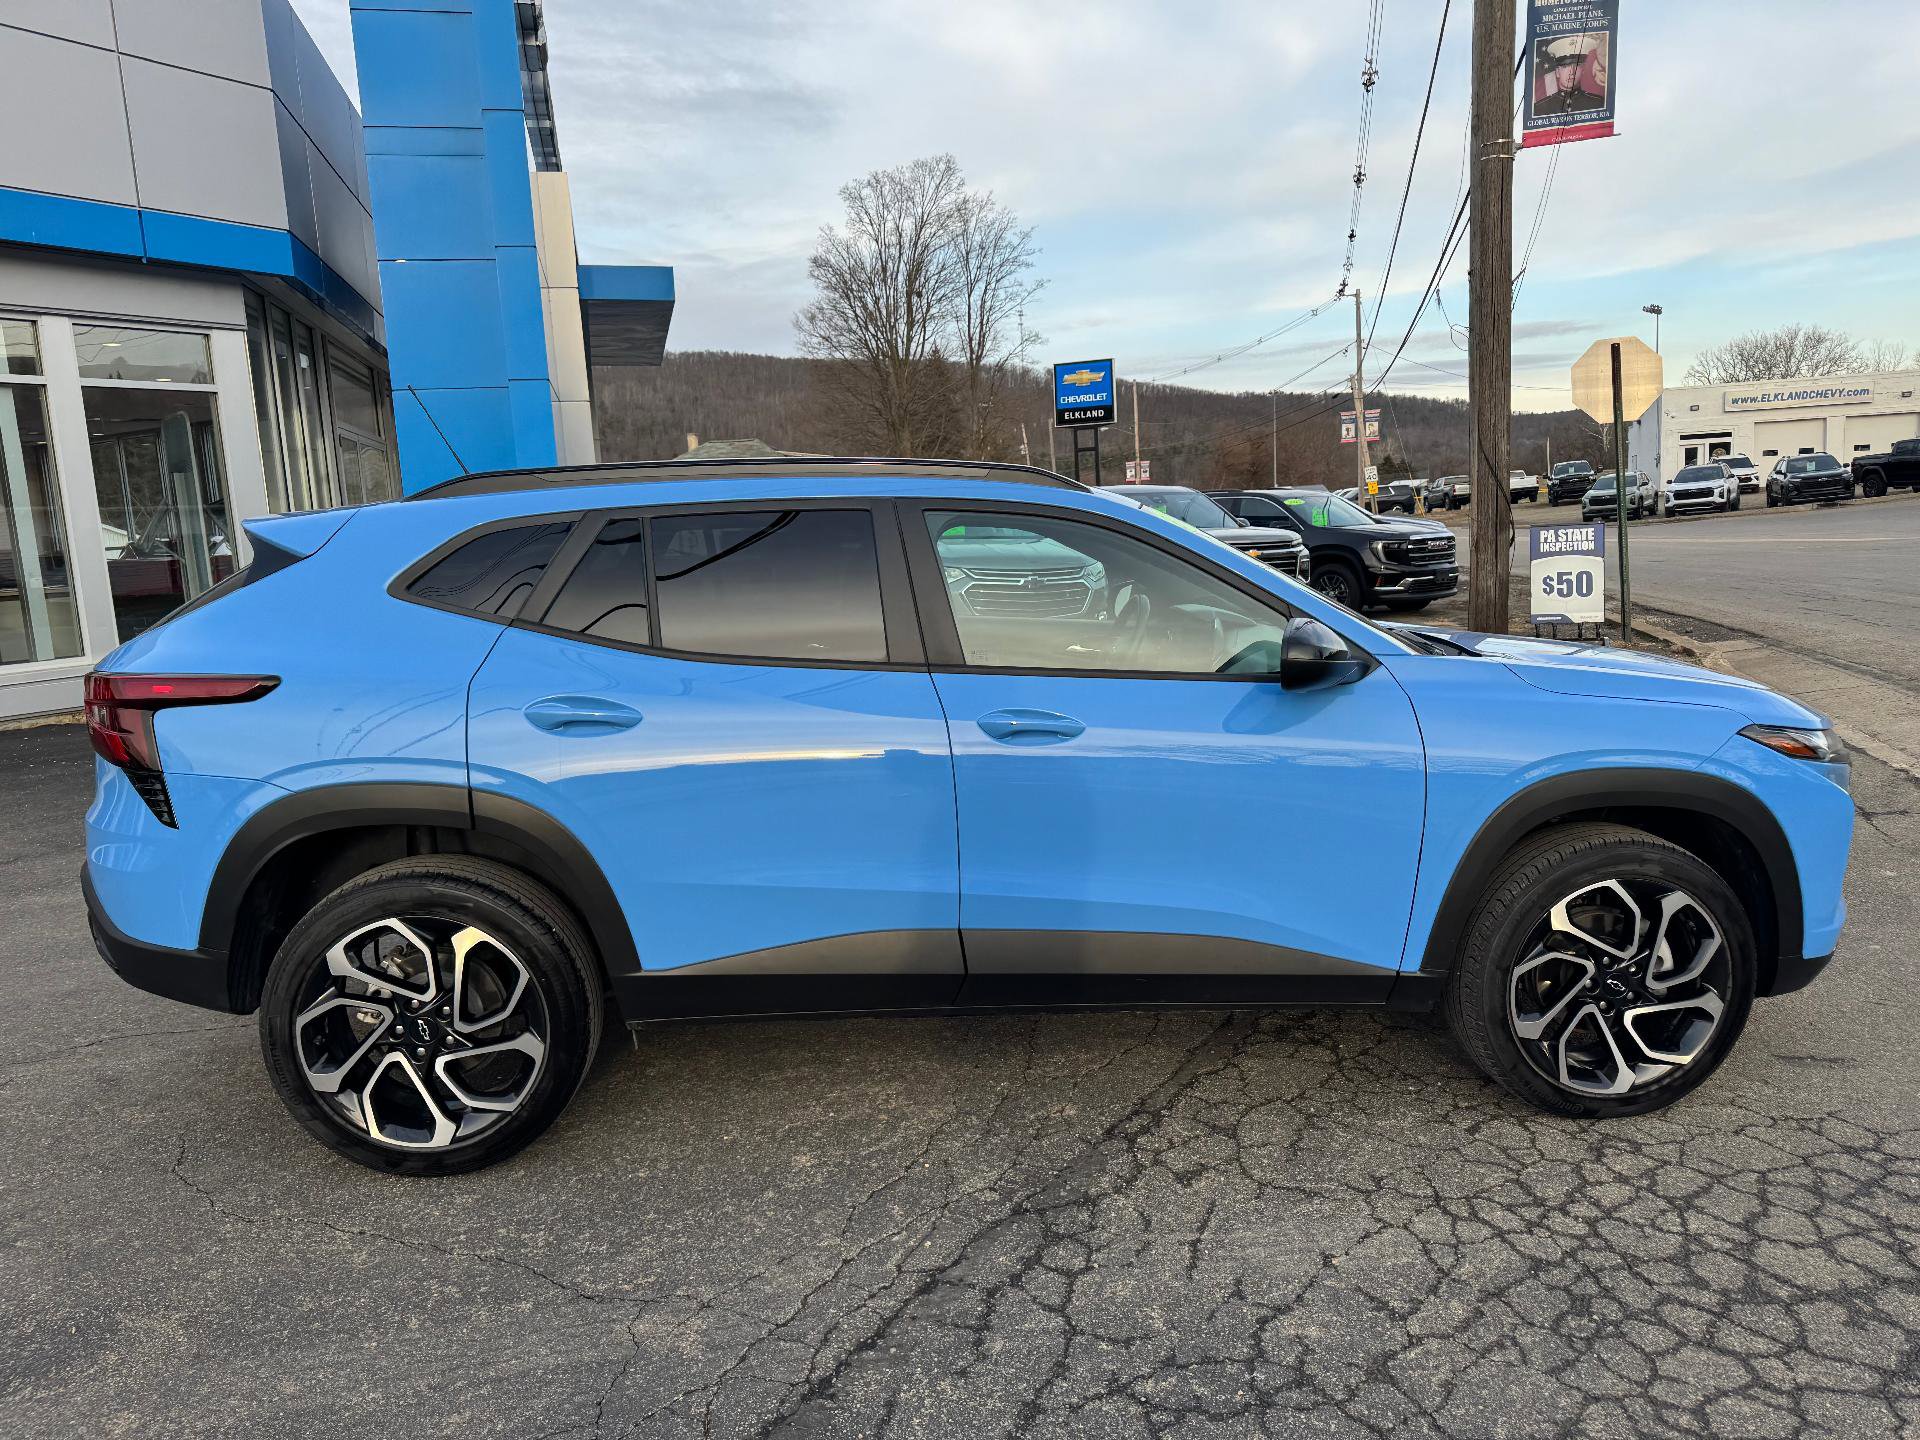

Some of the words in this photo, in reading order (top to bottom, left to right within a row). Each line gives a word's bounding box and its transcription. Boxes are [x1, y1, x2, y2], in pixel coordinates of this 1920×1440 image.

[1542, 12, 1577, 22] MICHAEL
[1578, 10, 1604, 18] PLANK
[1536, 25, 1550, 33] U.S.
[1551, 22, 1582, 31] MARINE
[1583, 19, 1609, 28] CORPS
[1527, 118, 1550, 127] GLOBAL
[1060, 392, 1107, 404] CHEVROLET
[1731, 388, 1870, 405] www.ELKLANDCHEVY.com
[1064, 409, 1104, 420] ELKLAND
[1540, 529, 1556, 543] PA
[1558, 527, 1595, 542] STATE
[1540, 540, 1595, 553] INSPECTION
[1541, 570, 1594, 598] $50
